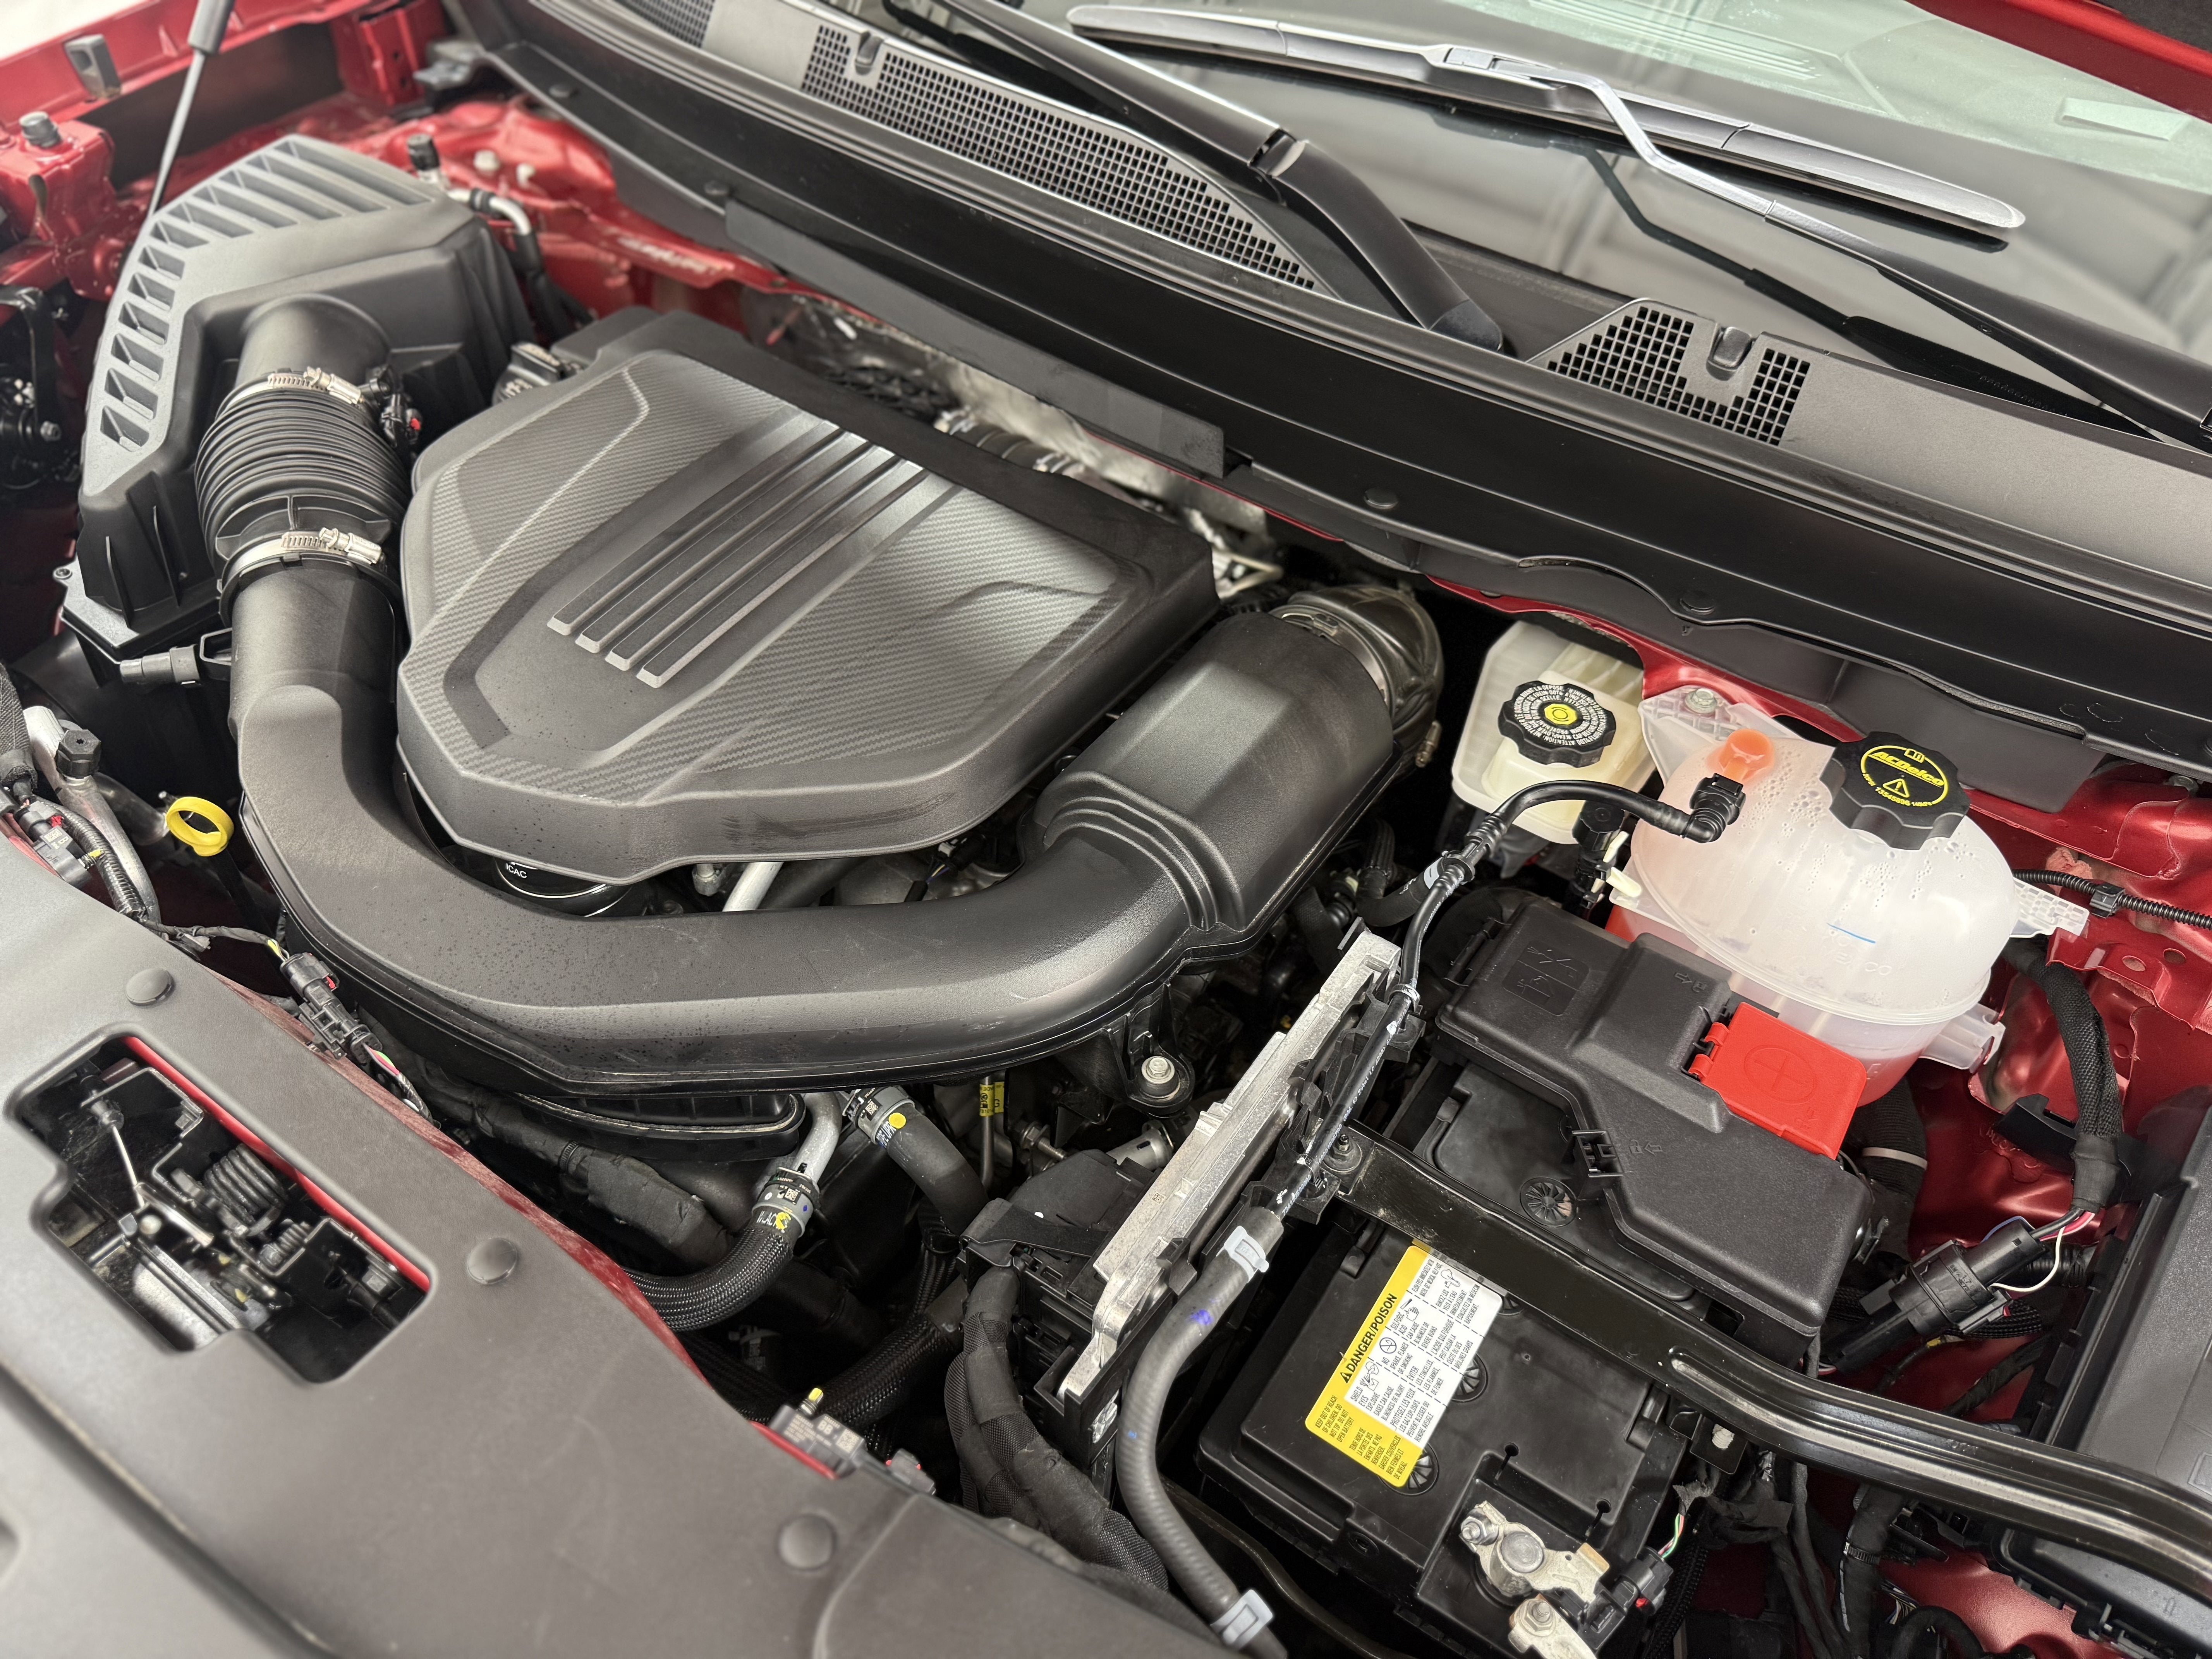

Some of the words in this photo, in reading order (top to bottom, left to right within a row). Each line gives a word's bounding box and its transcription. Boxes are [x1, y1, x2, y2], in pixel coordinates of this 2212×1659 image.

[1565, 692, 1580, 701] ONLY
[1577, 698, 1589, 706] USE
[1874, 751, 1944, 787] ACDelco
[1875, 787, 1911, 806] 13545896
[1443, 1301, 1451, 1311] YEUX
[1456, 1301, 1470, 1320] CONSULTEZ
[1390, 1311, 1405, 1330] SULFURIC
[1409, 1321, 1419, 1333] CAUSE
[1345, 1293, 1398, 1372] DANGER/POISON
[1398, 1324, 1408, 1335] ACID
[1406, 1331, 1414, 1340] CAN
[1413, 1326, 1427, 1344] BLINDNESS
[1430, 1339, 1443, 1355] L'ACIDE
[1437, 1318, 1454, 1342] SULFURIQUE
[1454, 1341, 1462, 1350] DES
[1462, 1340, 1473, 1353] GRAVES
[1381, 1357, 1390, 1365] NO
[1389, 1354, 1402, 1370] SPARKS,
[1397, 1341, 1409, 1356] FLAMES
[1400, 1352, 1413, 1369] SMOKING
[1438, 1349, 1448, 1360] PEUT
[1405, 1364, 1419, 1381] ÉVITER
[1426, 1365, 1441, 1384] FLAMMES,
[1415, 1377, 1423, 1386] LES
[1423, 1382, 1431, 1391] LES
[1433, 1377, 1444, 1391] FUMER
[1350, 1386, 1363, 1402] SHIELD
[1383, 1385, 1394, 1398] CAUSE
[1404, 1387, 1416, 1400] YEUX
[1358, 1395, 1369, 1407] EYES
[1365, 1391, 1380, 1411] EXPLOSIVE
[1379, 1396, 1388, 1405] CAN
[1381, 1400, 1396, 1421] BLINDNESS
[1394, 1384, 1405, 1398] INJURY
[1400, 1398, 1410, 1408] LES
[1314, 1417, 1324, 1428] KEEP
[1319, 1410, 1328, 1420] OUT
[1327, 1395, 1338, 1408] REACH
[1373, 1403, 1384, 1416] GASES
[1389, 1405, 1406, 1427] PROTÉGEZ
[1406, 1399, 1420, 1419] EXPLOSIFS
[1329, 1428, 1338, 1438] NOT
[1340, 1409, 1349, 1418] NOT
[1398, 1423, 1407, 1432] LES
[1402, 1416, 1411, 1425] GAZ
[1406, 1420, 1419, 1437] PEUVENT
[1414, 1405, 1427, 1422] BLESSER
[1414, 1426, 1426, 1443] RENDRE
[1421, 1412, 1434, 1429] AVEUGLE
[1336, 1431, 1346, 1443] OPEN
[1341, 1416, 1354, 1433] BATTERY
[1365, 1431, 1373, 1440] DES
[1349, 1439, 1359, 1451] TENIR
[1354, 1431, 1364, 1442] HORS
[1374, 1433, 1382, 1442] PAS
[1378, 1455, 1390, 1470] GARDER
[1385, 1434, 1401, 1457] COUVERCLES
[1386, 1465, 1395, 1475] BIEN
[1396, 1459, 1407, 1475] NIVEAU.
